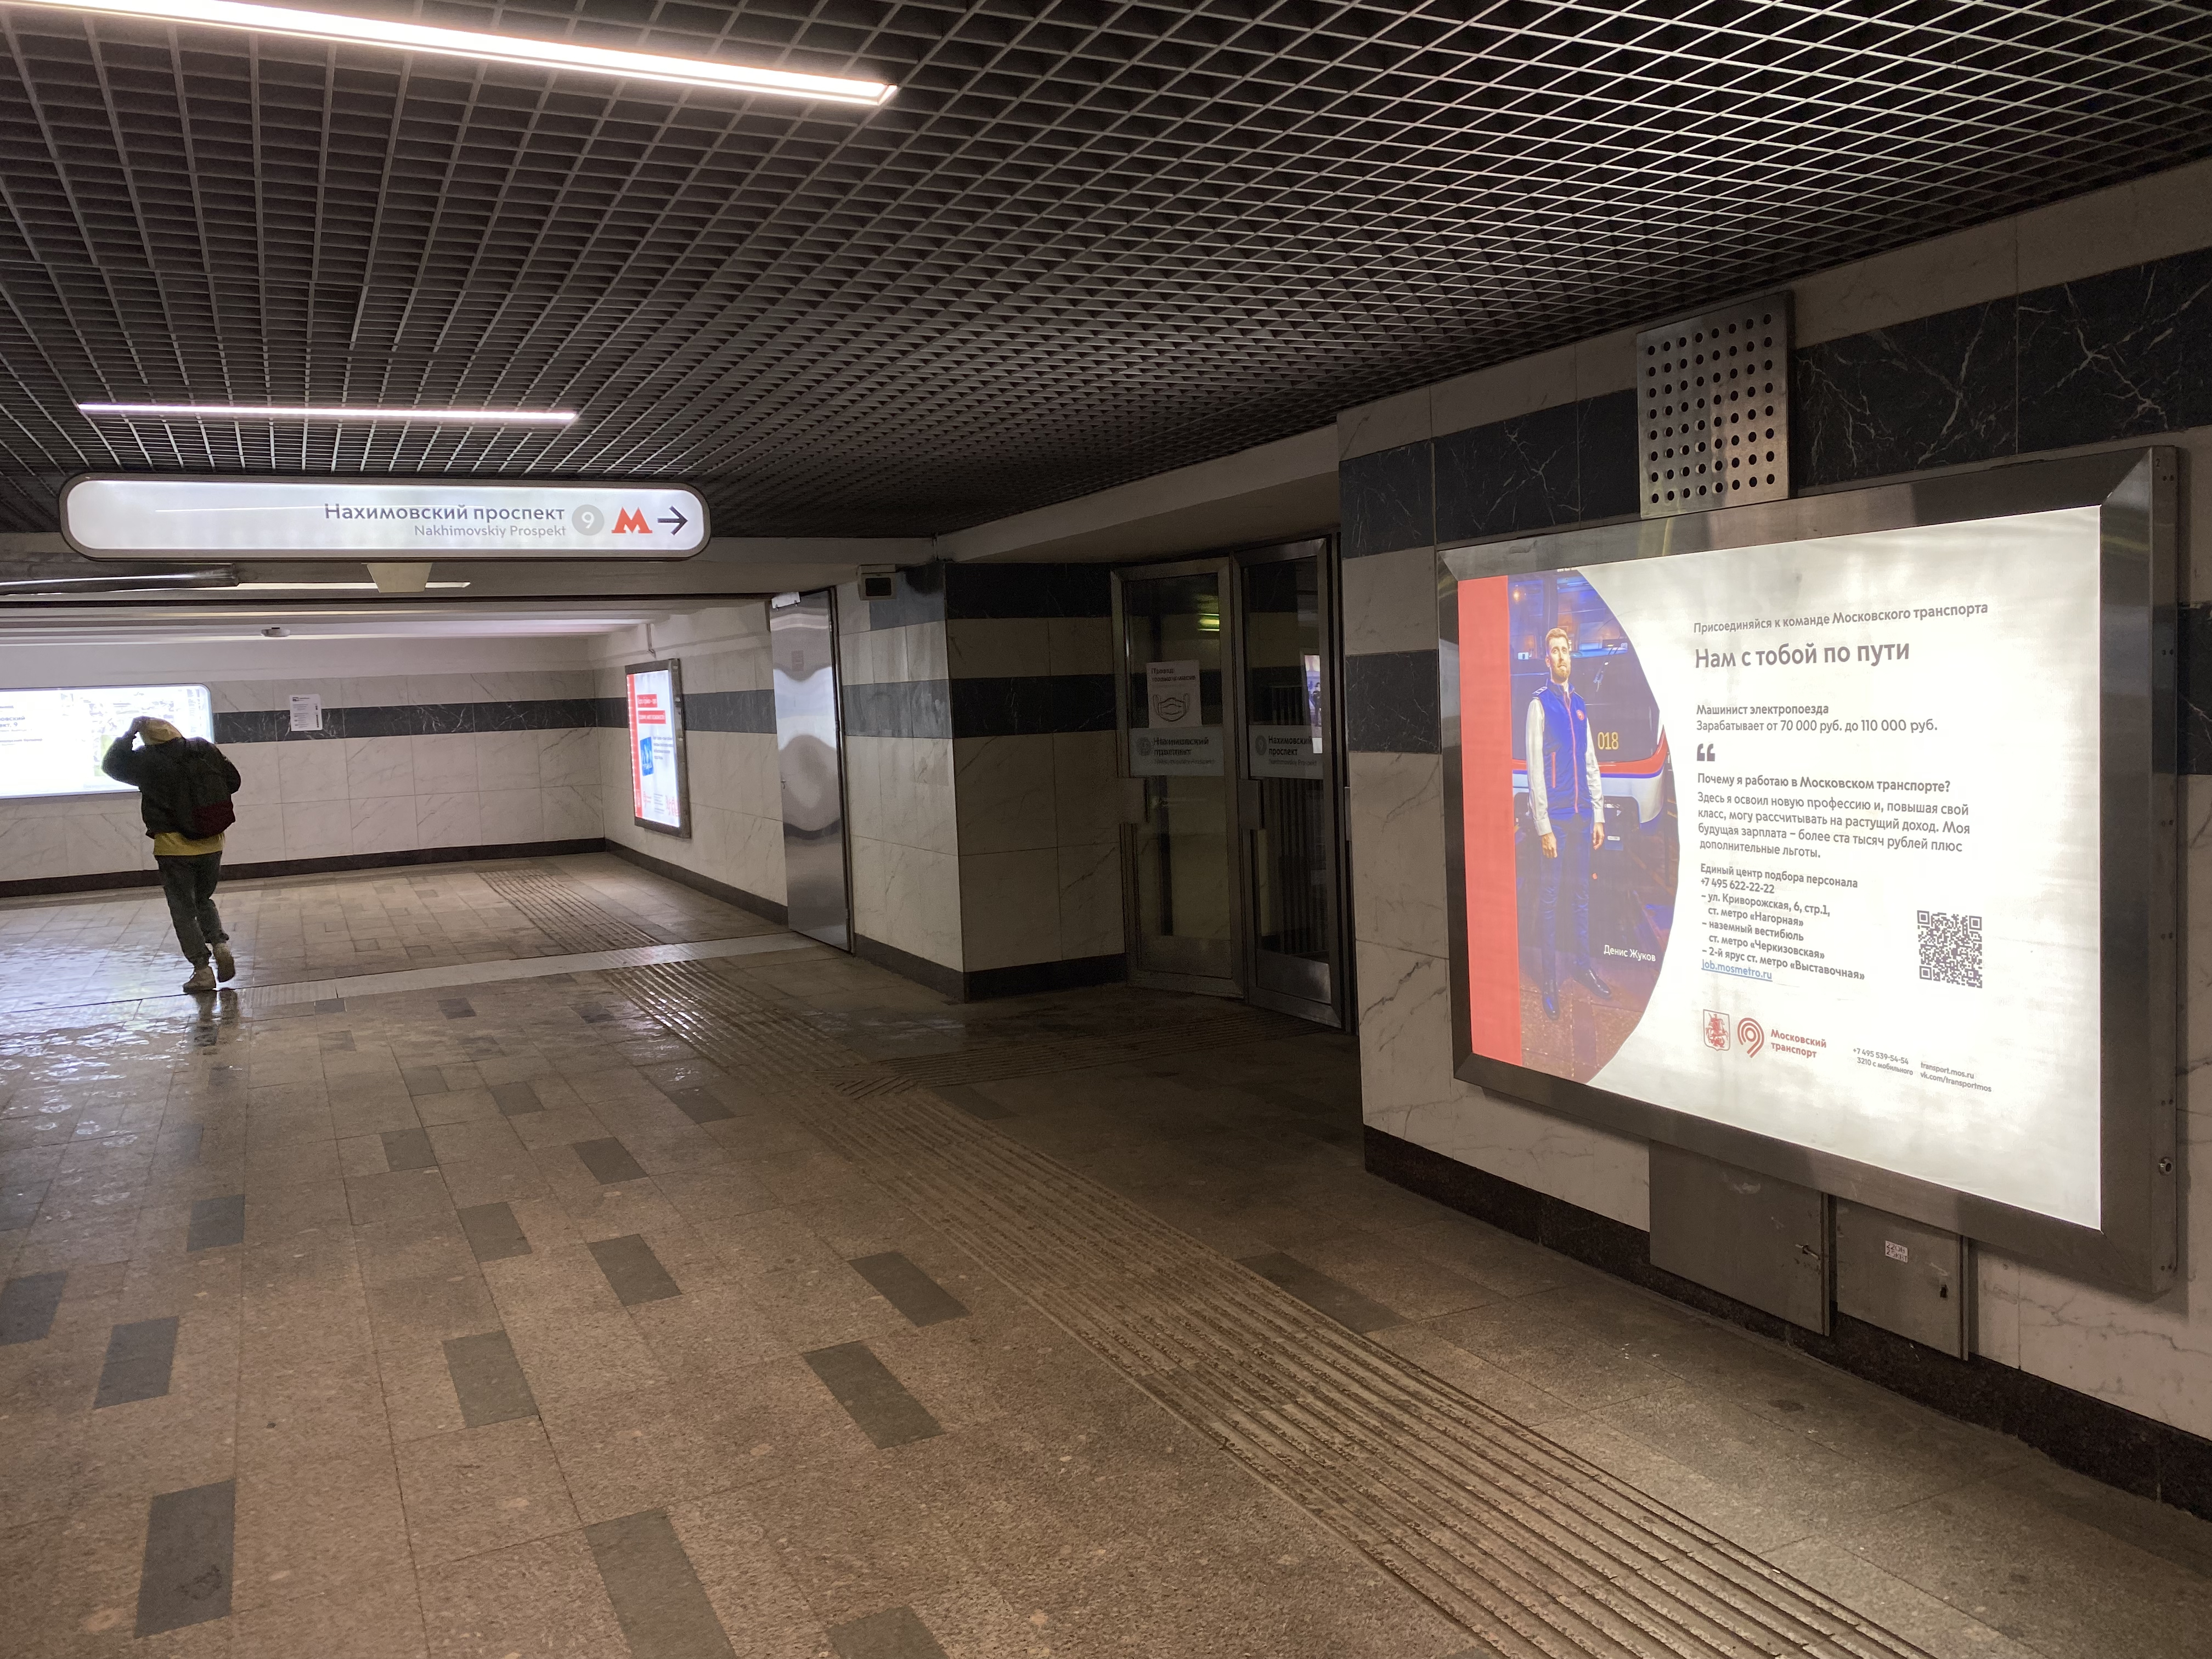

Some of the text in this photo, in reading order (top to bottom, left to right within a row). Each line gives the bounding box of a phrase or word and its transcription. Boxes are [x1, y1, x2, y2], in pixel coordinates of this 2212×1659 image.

[324, 503, 467, 519] Нахимовский
[473, 508, 565, 523] проспект
[582, 511, 595, 529] 9
[414, 524, 566, 538] Nakhimovskiy Prospekt
[1694, 619, 1771, 635] Присоединяйся
[1783, 616, 1830, 627] команде
[1832, 610, 1911, 624] Московского
[1914, 604, 1988, 620] транспорта
[1696, 642, 1909, 668] Нам с тобой по пути
[1696, 704, 1829, 716] Машинист электропоезда
[1696, 719, 1937, 733] Зарабатывает от 70 000 руб. до 110 000 руб.
[1268, 735, 1312, 745] Нахимовский
[1597, 731, 1620, 750] 018
[1268, 748, 1298, 757] проспект
[1698, 773, 1735, 787] Почему
[1745, 775, 1788, 787] работаю
[1800, 776, 1874, 789] Московском
[1877, 781, 1950, 794] транспорте?
[1697, 792, 1725, 803] Здесь
[1734, 796, 1768, 805] освоил
[1771, 798, 1804, 809] новую
[1807, 797, 1871, 811] профессию
[1874, 802, 1883, 812] и,
[1887, 803, 1938, 814] повышая
[1941, 804, 1968, 815] свой
[1699, 810, 1970, 834] класс, могу рассчитывать на растущий доход. Моя
[1699, 822, 1739, 836] будущая
[1741, 828, 1787, 839] зарплата
[1798, 829, 1830, 842] более
[1833, 834, 1850, 843] ста
[1853, 836, 1884, 846] тысяч
[1887, 836, 1927, 850] рублей
[1931, 842, 1962, 852] плюс
[1700, 840, 1820, 858] дополнительные льготы.
[1701, 863, 1858, 888] Единый центр подбора персонала
[1701, 877, 1775, 894] +7 495 622-22-22
[1708, 894, 1720, 902] ул.
[1723, 893, 1791, 912] Криворожская,
[1793, 901, 1802, 913] 6,
[1804, 905, 1830, 917] стр.1,
[1720, 909, 1748, 920] метро
[1750, 911, 1803, 927] «Нагорная»
[1709, 921, 1752, 934] наземный
[1755, 928, 1804, 941] вестибюль
[1604, 944, 1656, 962] Денис Жуков
[1721, 937, 1748, 948] метро
[1750, 939, 1825, 959] «Черкизовская»
[1701, 959, 1773, 981] job.mosmetro.ru
[1709, 947, 1723, 957] 2-й
[1725, 952, 1745, 962] ярус
[1747, 955, 1757, 963] ст.
[1759, 957, 1788, 969] метро
[1790, 960, 1865, 980] «Выставочная»
[1771, 1029, 1826, 1048] Московский
[1771, 1042, 1816, 1058] транспорт
[1876, 1052, 1909, 1065] 539-54-54
[1857, 1057, 1871, 1065] 3210
[1877, 1063, 1913, 1075] мобильного
[1921, 1062, 1974, 1079] transport.mos.ru
[1920, 1071, 1991, 1092] vk.com/transportmos
